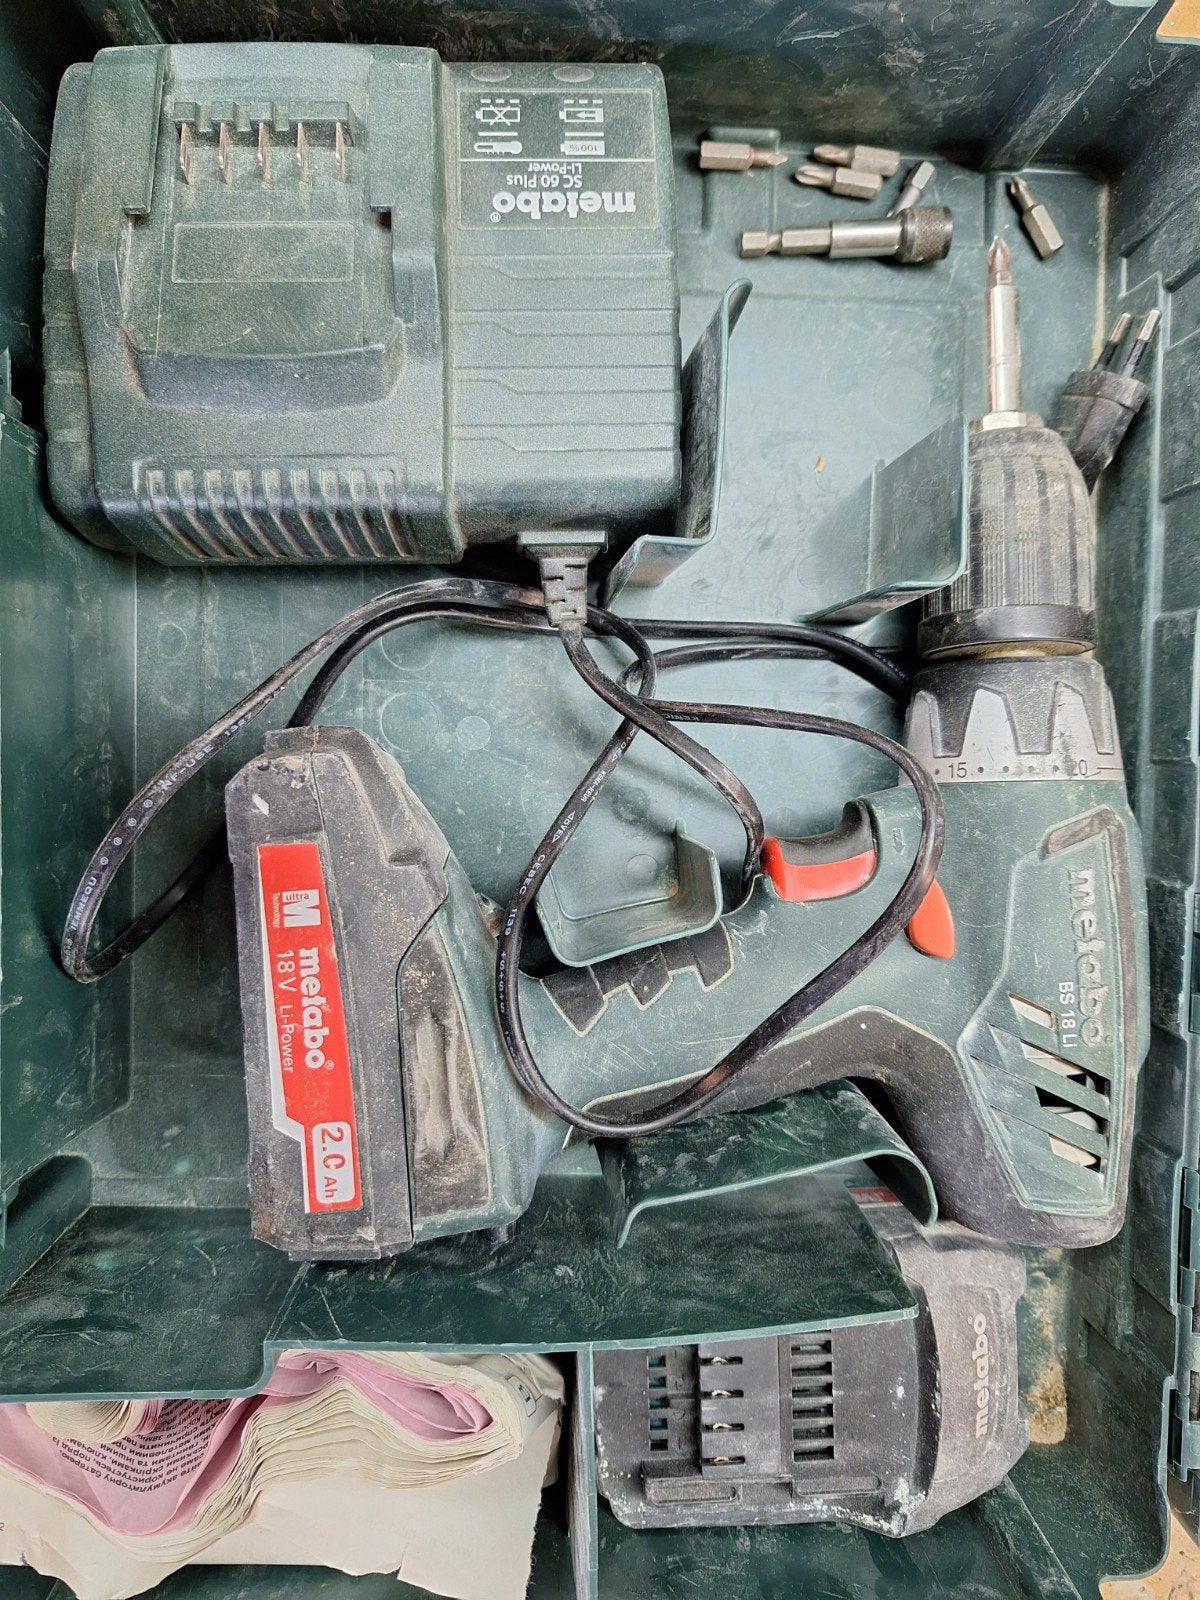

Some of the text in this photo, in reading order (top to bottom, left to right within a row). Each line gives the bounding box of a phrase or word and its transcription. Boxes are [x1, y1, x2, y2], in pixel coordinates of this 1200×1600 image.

[506, 174, 583, 188] SC 60 Plus
[948, 762, 968, 778] 15
[285, 892, 310, 902] ultra
[504, 854, 546, 936] CEBEC 1139
[272, 892, 281, 929] Technology
[276, 949, 297, 1073] 18 V Li-Power
[1058, 981, 1078, 1048] BS 18 Li
[323, 1175, 337, 1200] Ah
[62, 1442, 90, 1462] поряд
[100, 1443, 135, 1465] іншими
